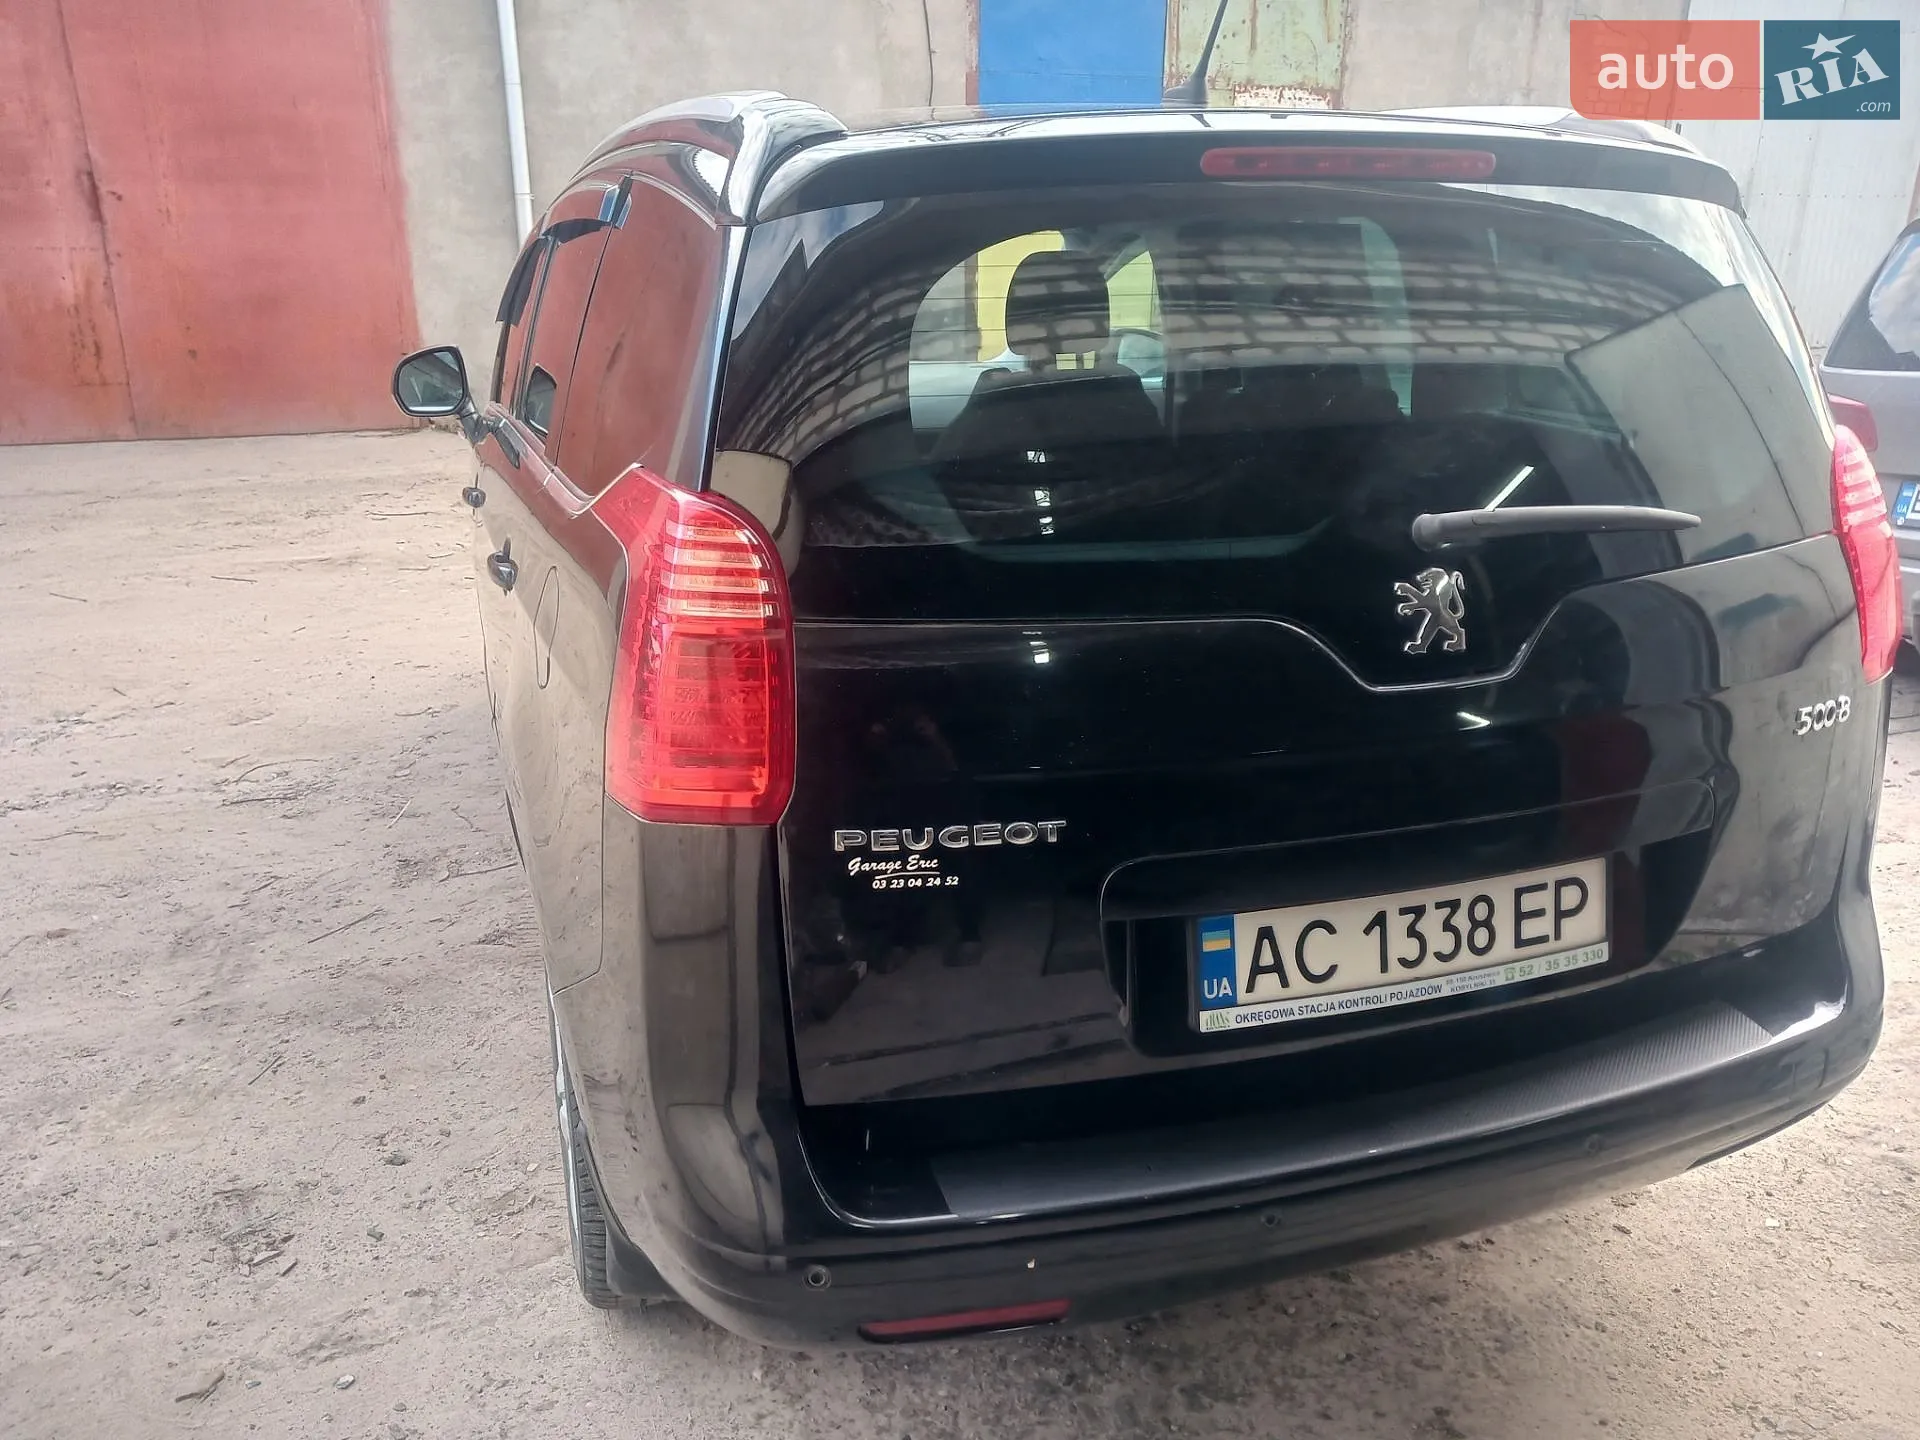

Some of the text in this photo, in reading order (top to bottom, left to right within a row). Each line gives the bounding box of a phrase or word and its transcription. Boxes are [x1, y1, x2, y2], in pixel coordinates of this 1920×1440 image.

[1795, 695, 1851, 736] 5008
[834, 819, 1067, 852] PEUGEOT
[848, 857, 902, 876] Garage
[872, 876, 960, 889] 03 23 04 24 52
[1245, 875, 1589, 994] AC 1338 EP
[1519, 964, 1534, 977] 52
[1545, 957, 1560, 971] 35
[1563, 954, 1579, 968] 35
[1583, 949, 1604, 963] 330
[1204, 977, 1232, 999] UA
[1235, 1007, 1295, 1024] OKRĘGOWA
[1297, 1002, 1337, 1016] STACJA
[1338, 994, 1387, 1010] KONTROLI
[1389, 983, 1443, 1002] POJAZDÓW
